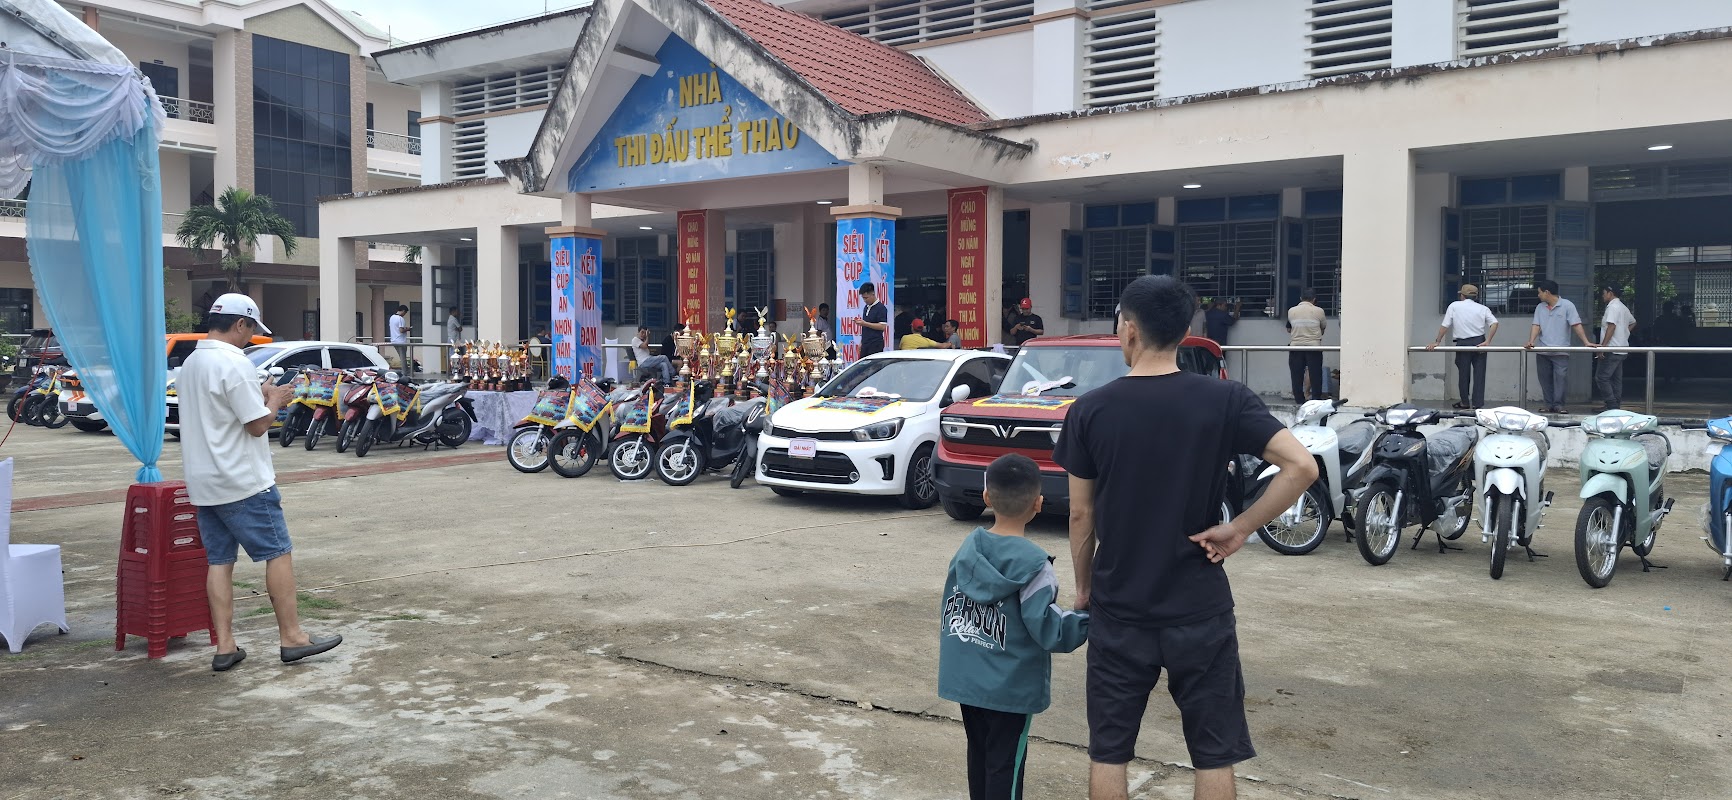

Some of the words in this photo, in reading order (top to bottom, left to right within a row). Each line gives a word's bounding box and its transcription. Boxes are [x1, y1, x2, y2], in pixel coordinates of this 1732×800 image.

[679, 63, 722, 108] NHÀ
[614, 134, 646, 167] THI
[650, 117, 689, 164] ĐẤU
[692, 105, 732, 159] THỂ
[737, 117, 799, 154] THAO
[961, 197, 976, 213] CHÀO
[843, 229, 864, 254] SIÊU
[876, 229, 889, 263] KẾT
[958, 237, 965, 250] 50
[966, 235, 979, 250] NĂM
[555, 246, 570, 266] SIÊU
[581, 247, 596, 275] KẾT
[961, 252, 975, 268] NGÀY
[844, 256, 862, 281] CÚP
[557, 270, 569, 290] CÚP
[877, 273, 888, 306] NỐI
[559, 296, 567, 312] AN
[582, 284, 595, 310] NỐI
[847, 290, 859, 308] AN
[959, 289, 977, 304] PHÓNG
[959, 310, 968, 325] THỊ
[969, 307, 976, 322] XÃ
[555, 317, 572, 336] NHƠN
[580, 326, 596, 346] ĐAM
[556, 339, 570, 358] NĂM
[583, 357, 594, 380] MÊ
[942, 592, 1006, 651] PERSON
[948, 615, 980, 642] Relax
[970, 637, 994, 650] PERFECT
